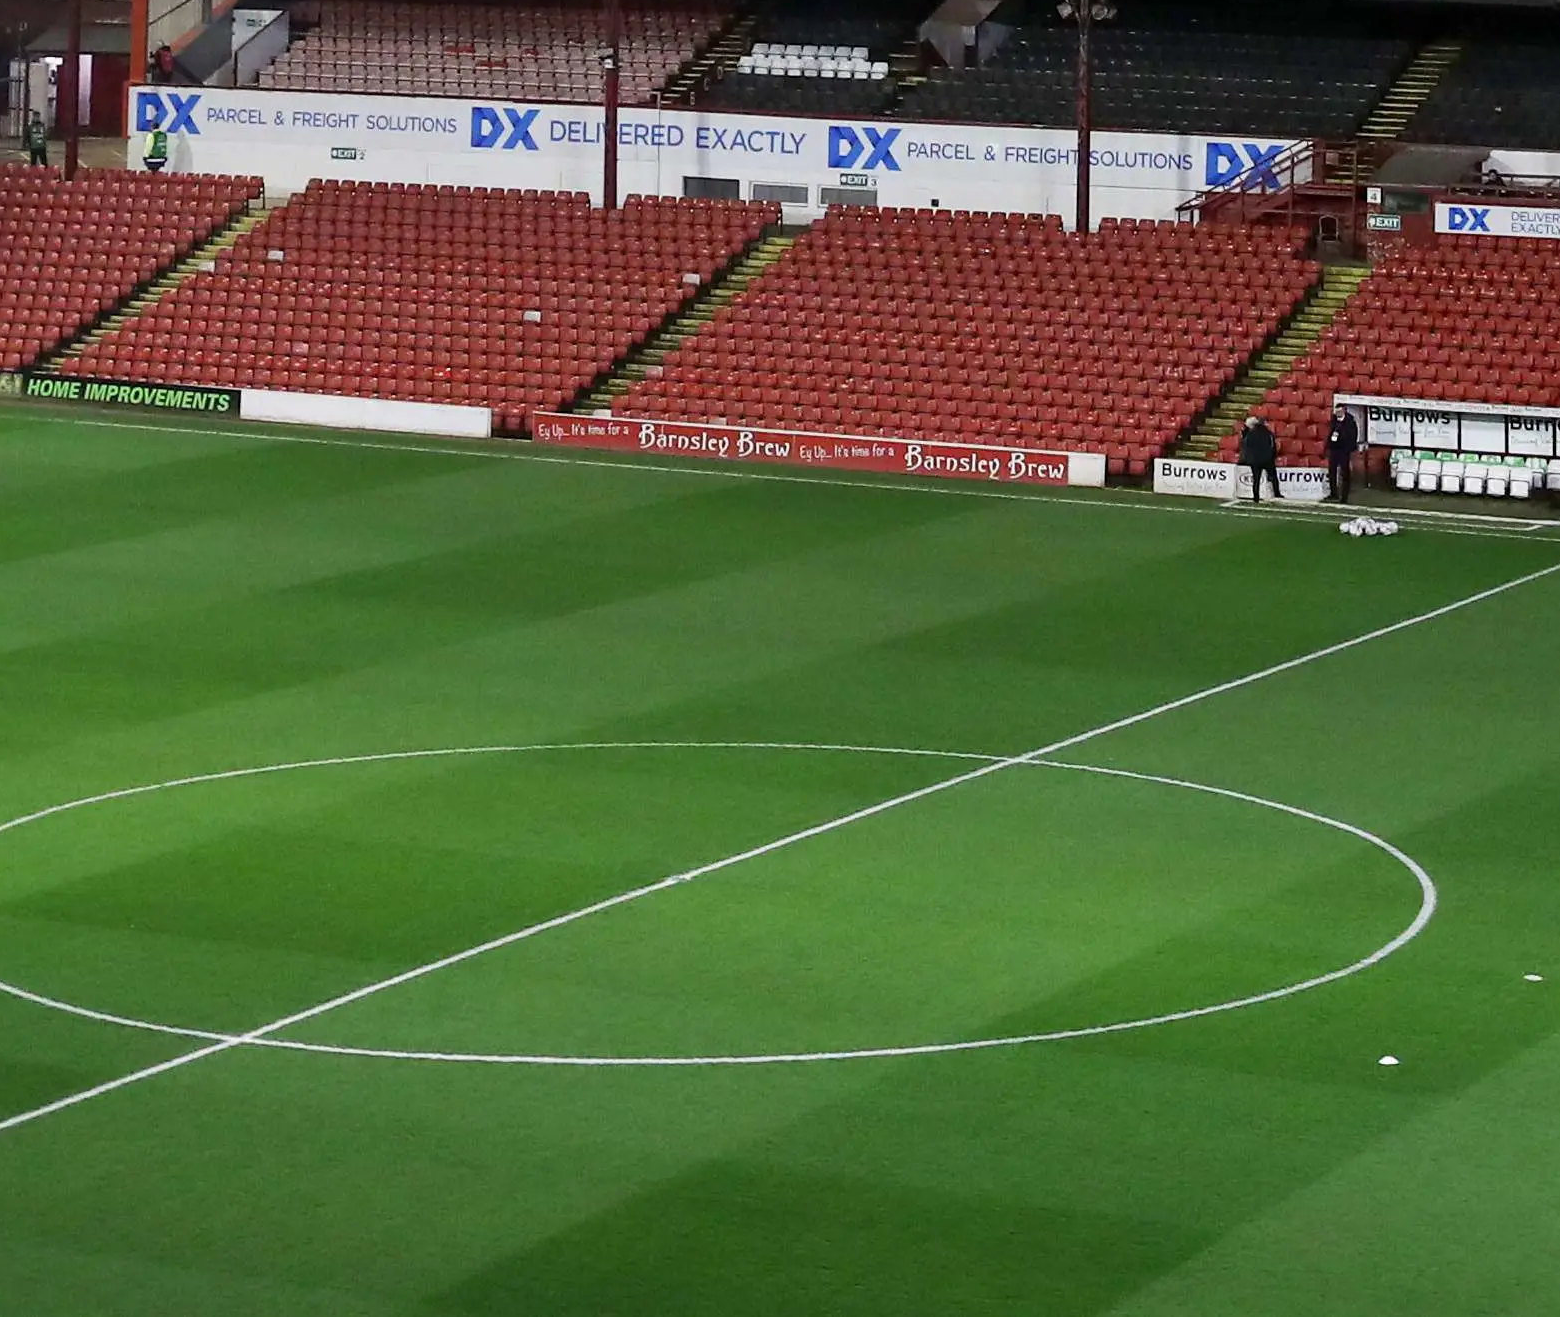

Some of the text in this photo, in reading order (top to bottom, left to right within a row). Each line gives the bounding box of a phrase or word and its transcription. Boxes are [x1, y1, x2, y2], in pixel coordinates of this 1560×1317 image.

[136, 91, 457, 135] DX PARCEL & FREIGHT SOLUTIONS
[470, 106, 541, 151] DX
[696, 127, 806, 155] EXACTLY
[828, 126, 1286, 189] DX PARCEL & FREIGHT SOLUTIONS DX
[848, 176, 868, 185] EXIT
[1370, 191, 1379, 202] 4
[1375, 217, 1399, 228] EXIT
[1448, 207, 1491, 232] DX
[27, 378, 230, 412] HOME IMPROVEMENTS
[539, 424, 551, 441] Ey
[571, 424, 586, 437] It's
[607, 422, 622, 436] for
[622, 426, 630, 435] a
[638, 422, 791, 458] Barnsley Brew
[799, 446, 812, 463] Ey
[834, 446, 849, 459] It's
[871, 442, 887, 457] for
[888, 447, 895, 456] a
[904, 444, 1065, 480] Barnsley Brew
[1161, 463, 1227, 481] Burrows
